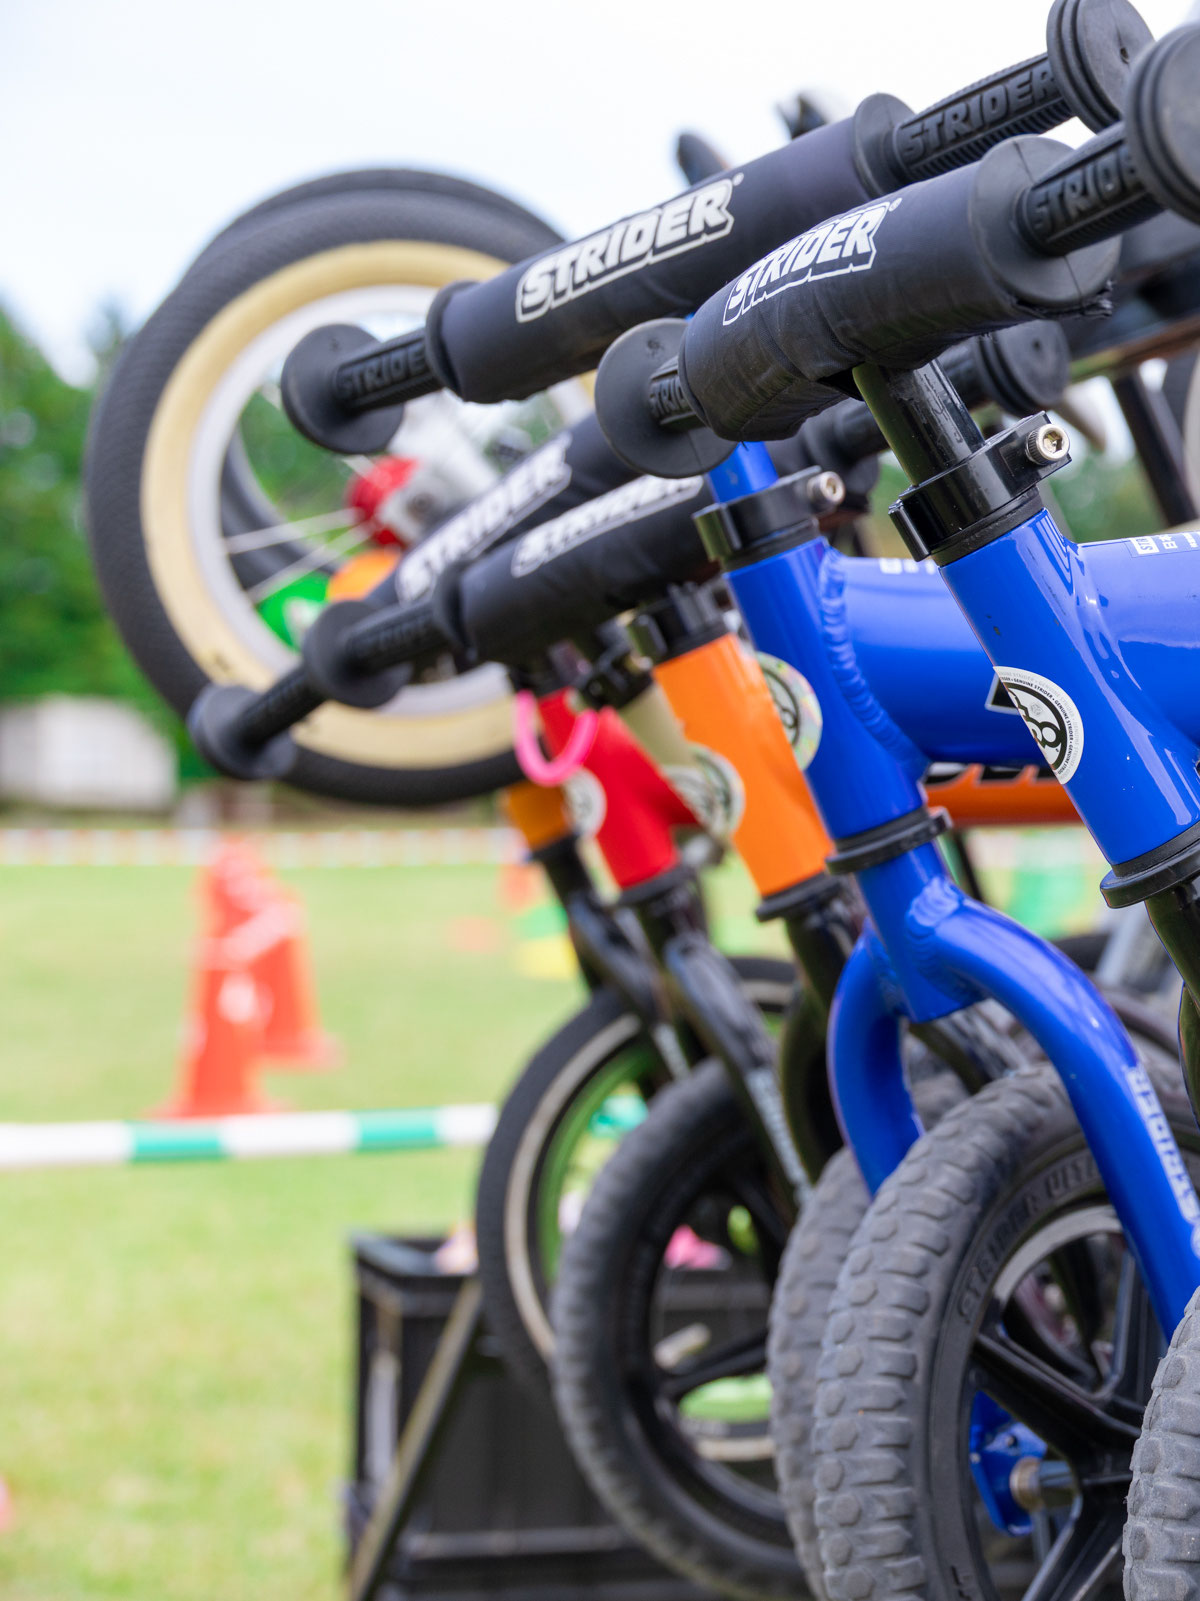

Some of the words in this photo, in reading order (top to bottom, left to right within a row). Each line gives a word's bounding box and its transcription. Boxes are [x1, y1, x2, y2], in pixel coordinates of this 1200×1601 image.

[900, 60, 1062, 166] STRIDER
[1026, 146, 1144, 234] STRIDE
[516, 179, 734, 323] STRIDER
[723, 200, 892, 325] STRIDER
[336, 342, 427, 400] STRIDE
